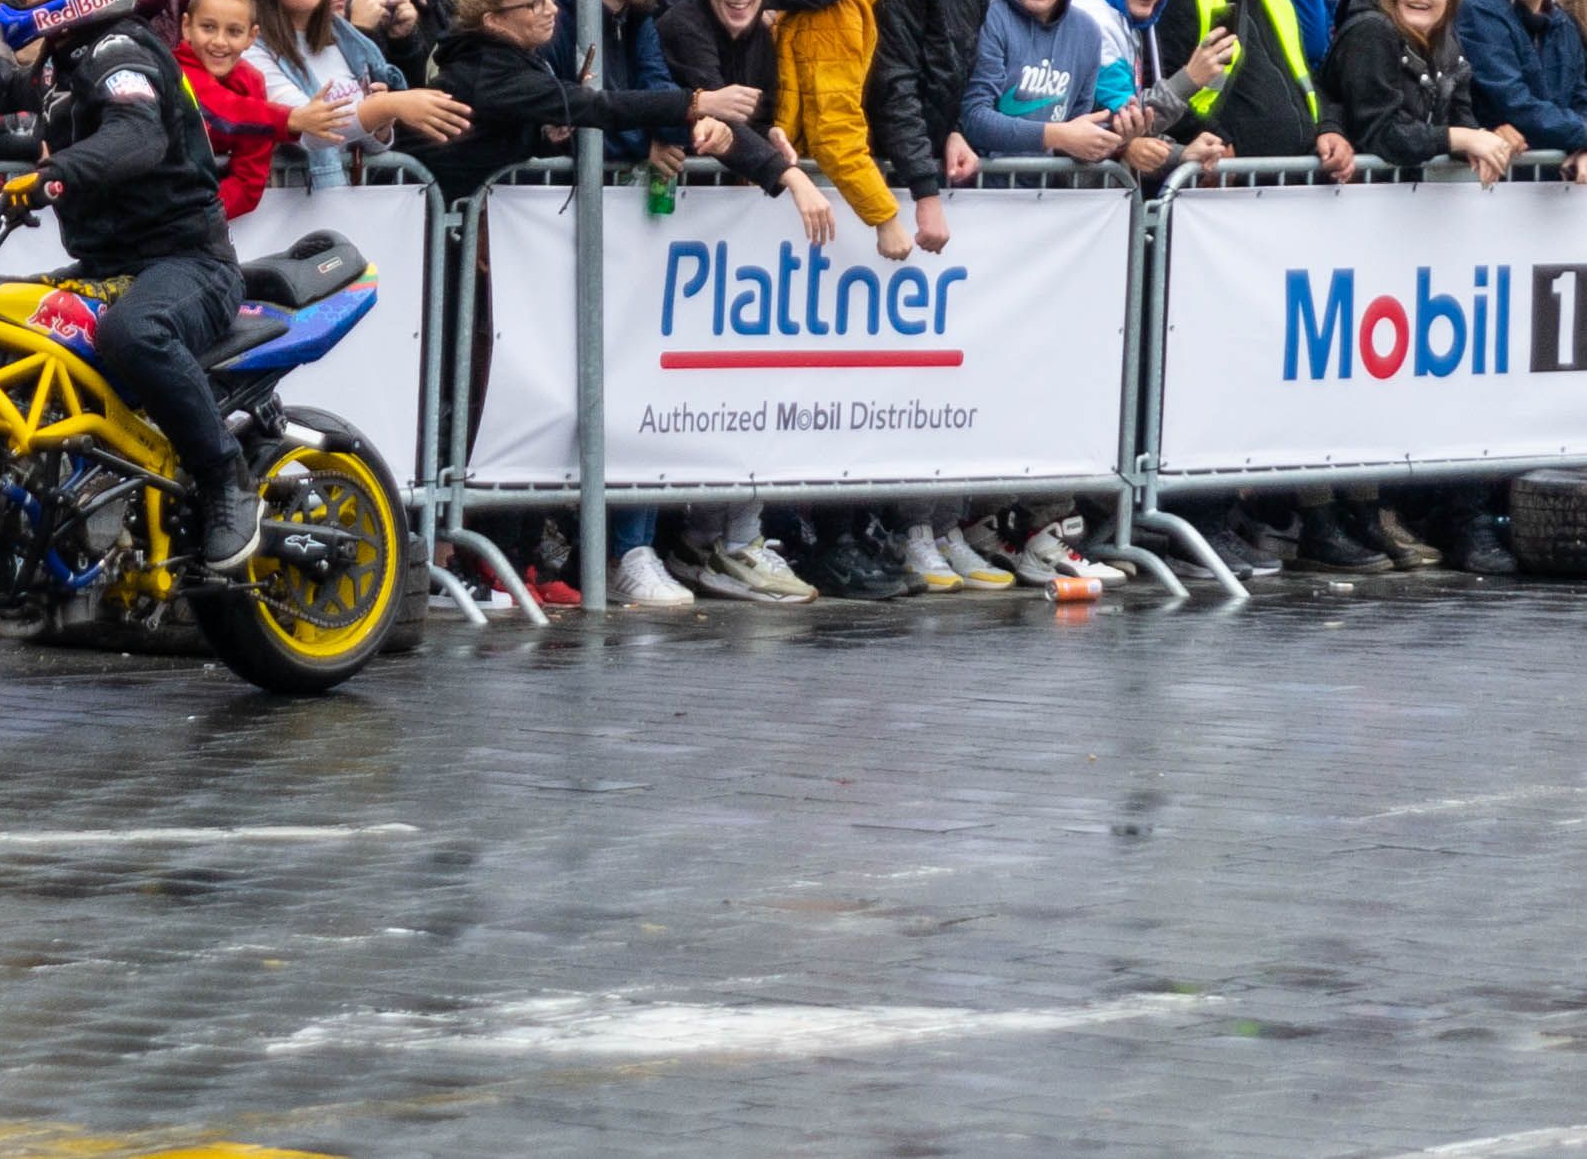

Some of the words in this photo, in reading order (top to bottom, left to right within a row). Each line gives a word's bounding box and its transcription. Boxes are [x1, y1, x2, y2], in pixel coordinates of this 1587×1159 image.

[1019, 58, 1071, 96] nike
[660, 240, 968, 336] Plattner
[1283, 265, 1511, 381] Mobil
[1551, 270, 1578, 366] 1
[638, 401, 768, 433] Authorized
[776, 401, 842, 431] Mobil
[850, 399, 978, 430] Distributor
